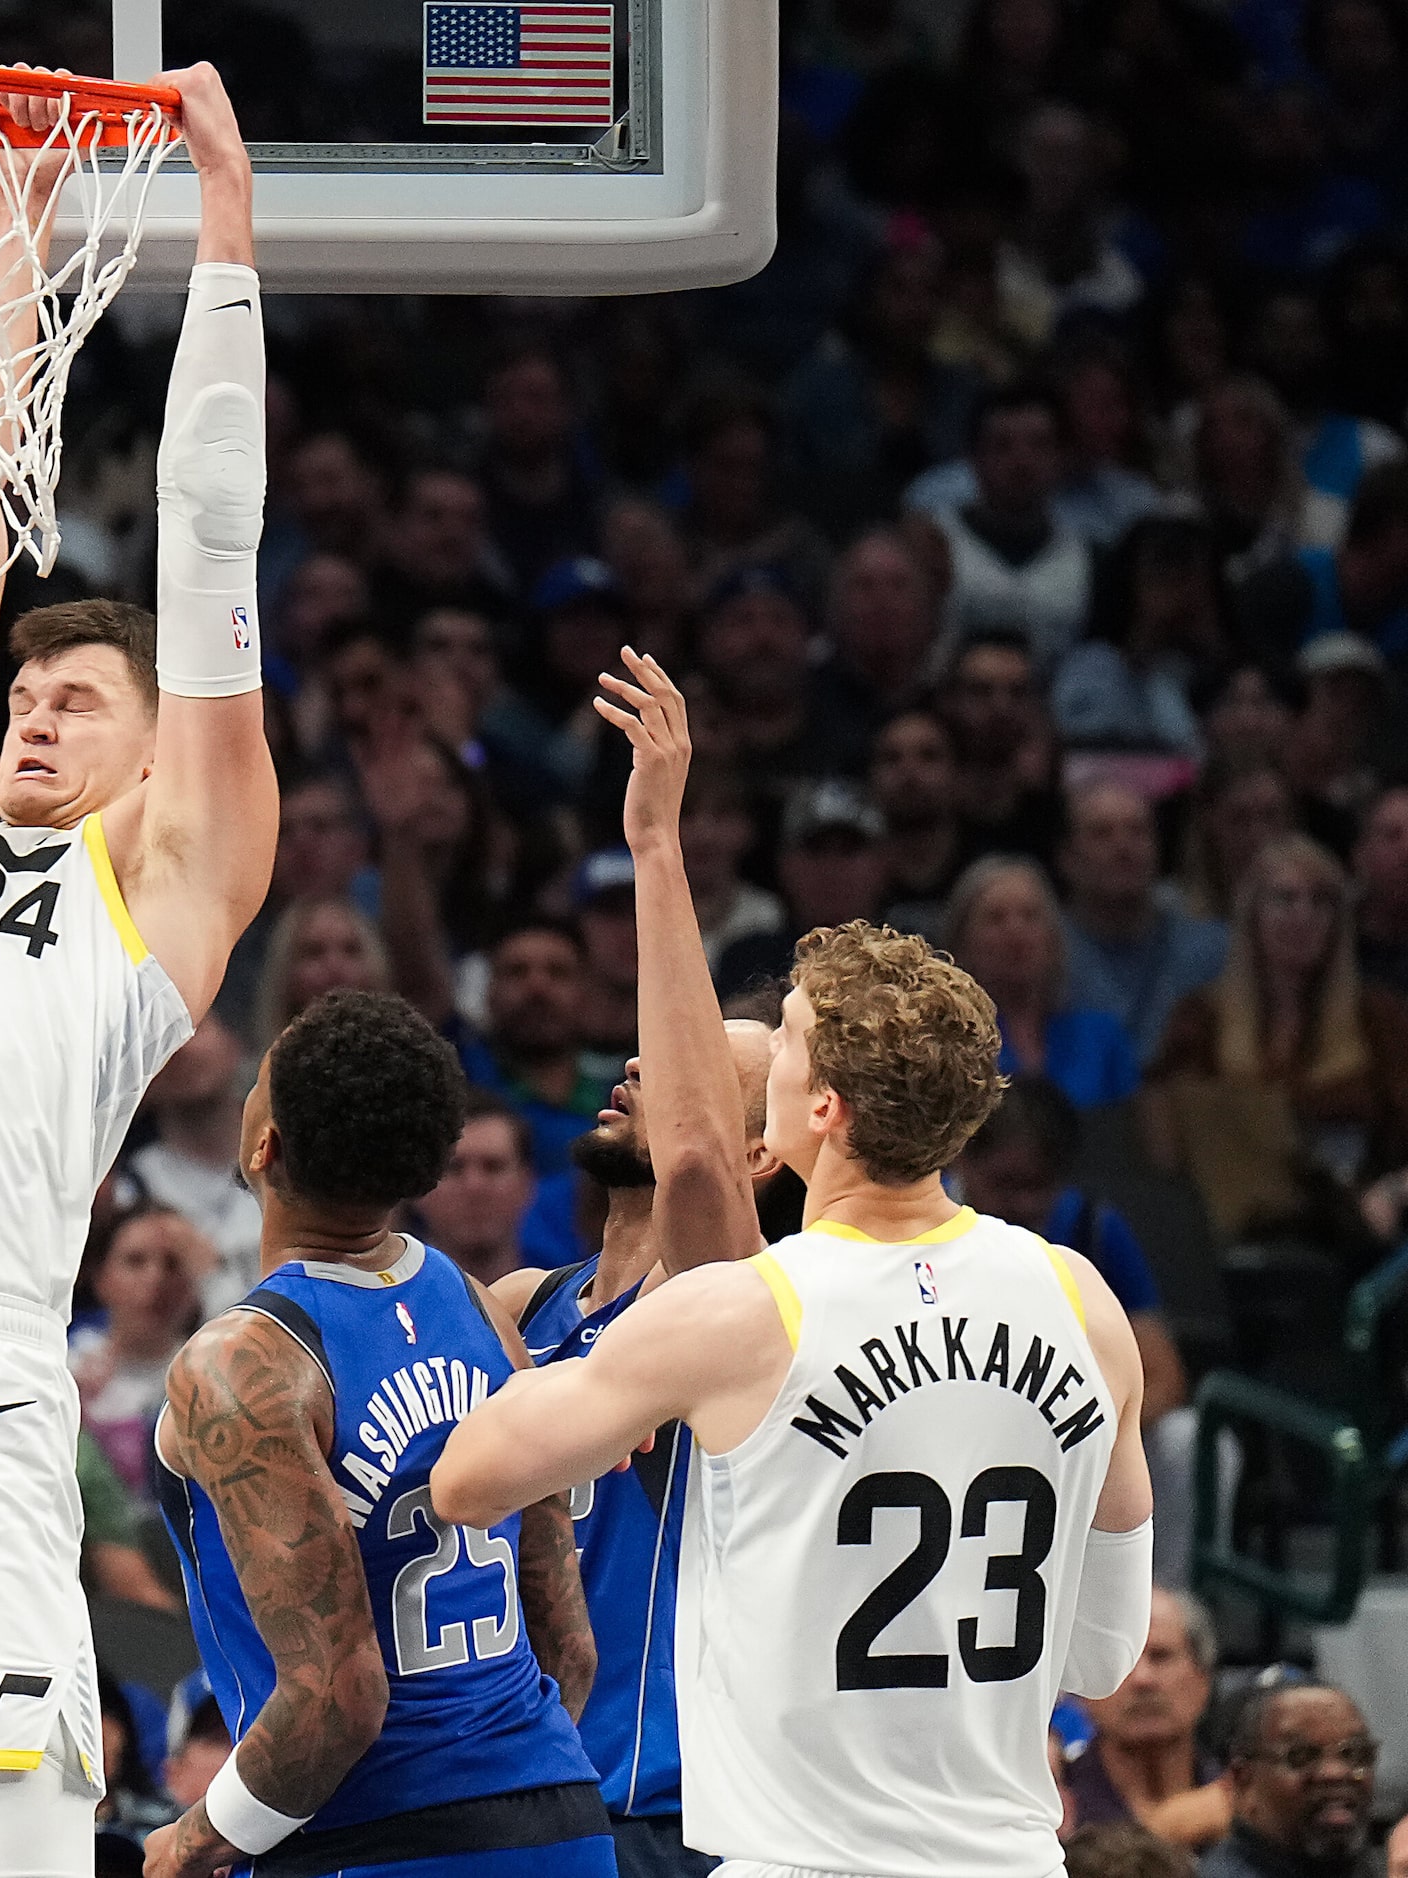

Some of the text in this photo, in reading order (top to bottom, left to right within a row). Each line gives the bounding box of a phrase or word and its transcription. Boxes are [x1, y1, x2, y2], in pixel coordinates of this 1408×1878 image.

[790, 1316, 1106, 1461] MARKKANEN
[387, 1483, 519, 1677] 25
[836, 1464, 1057, 1692] 23
